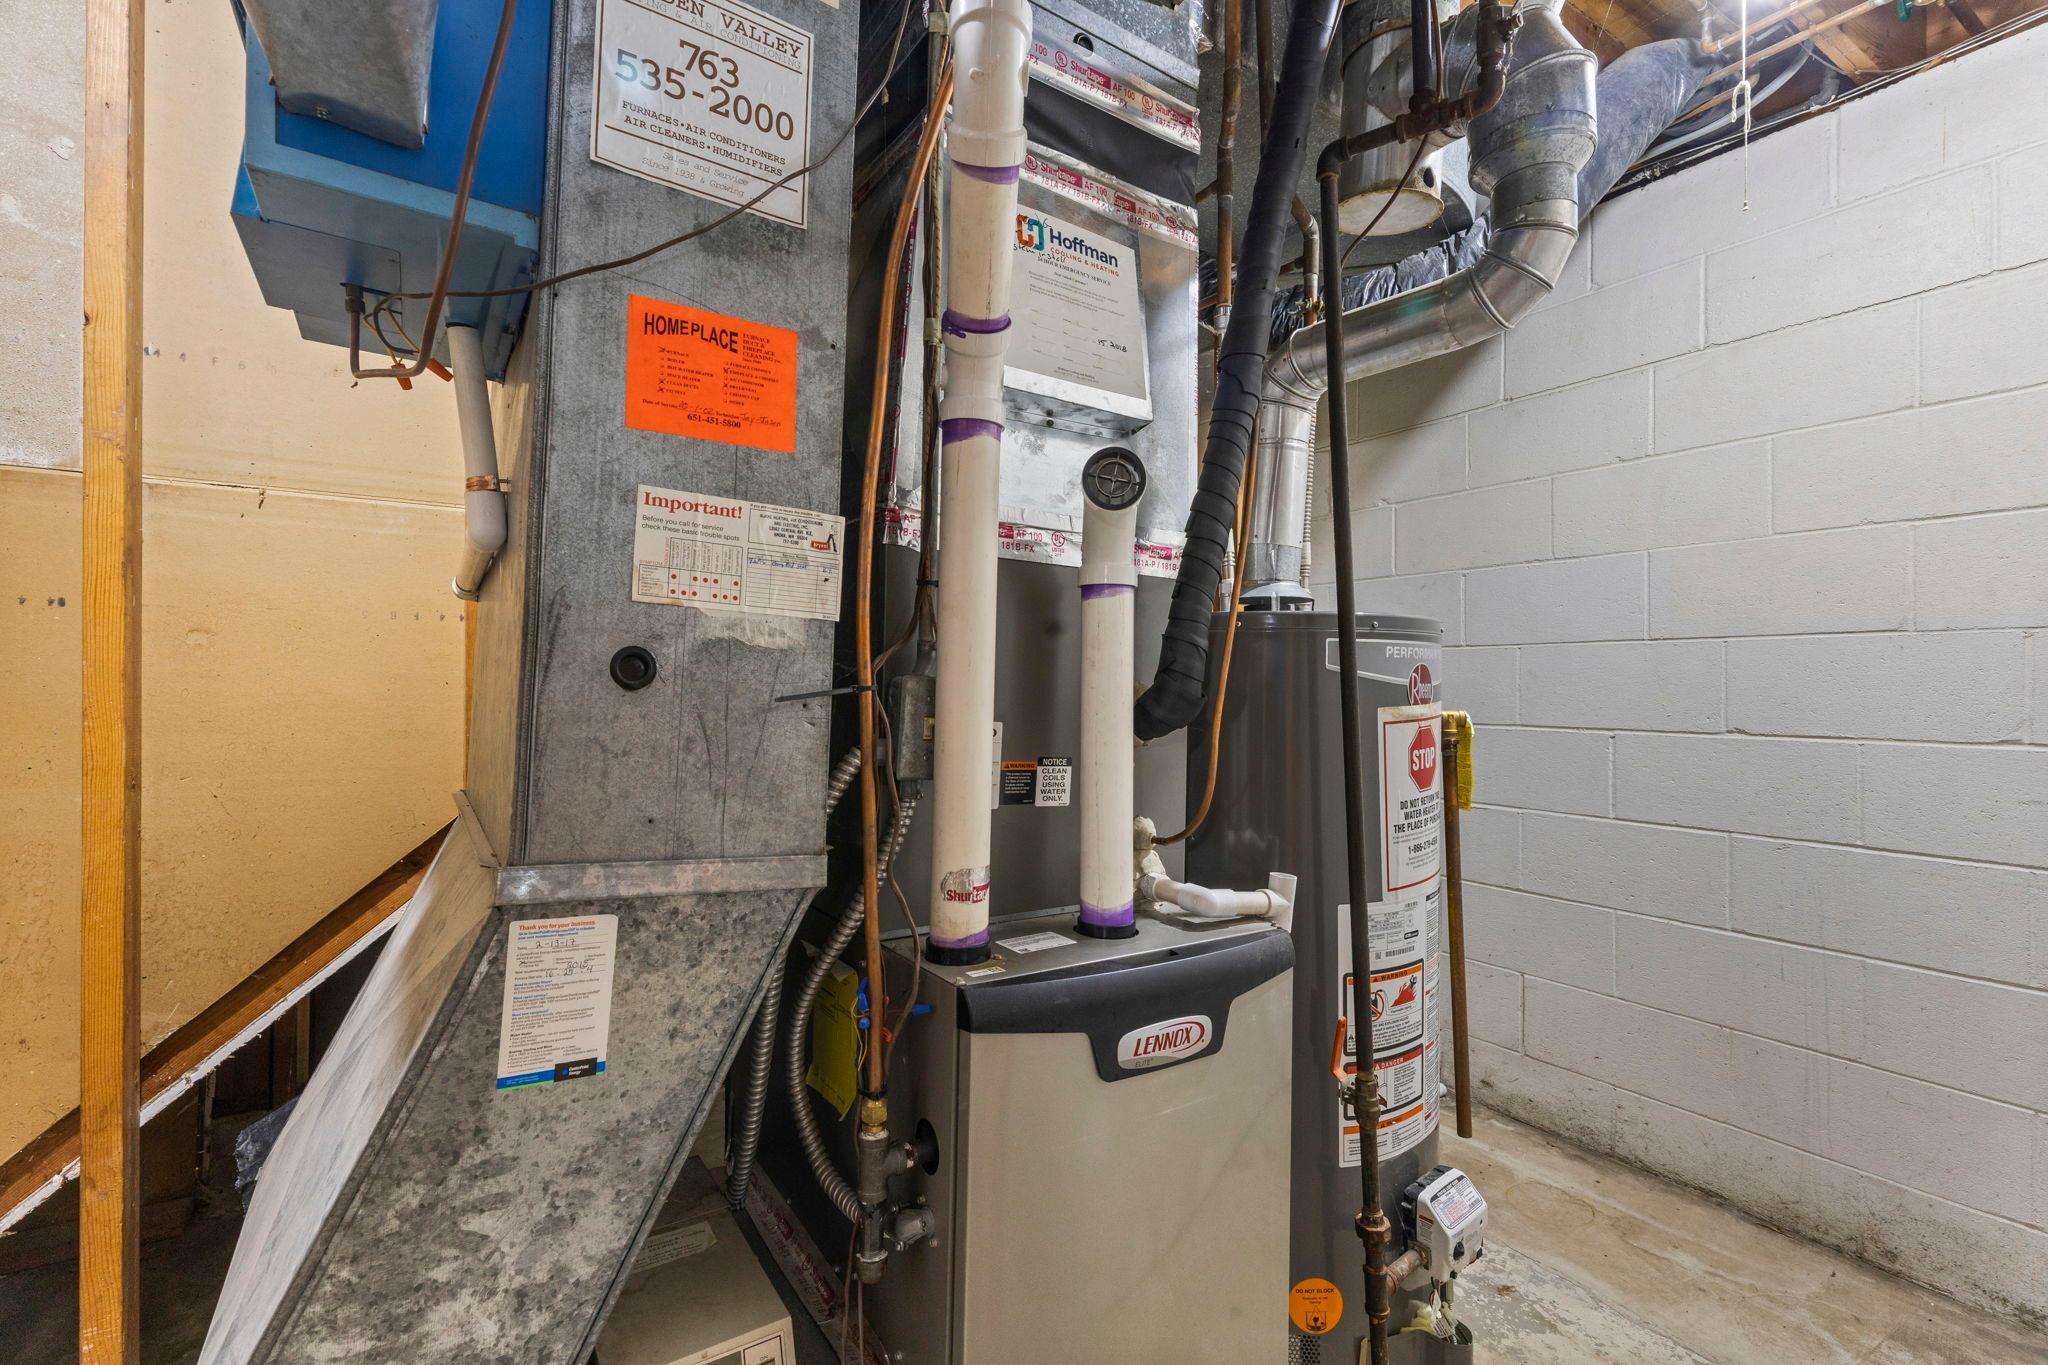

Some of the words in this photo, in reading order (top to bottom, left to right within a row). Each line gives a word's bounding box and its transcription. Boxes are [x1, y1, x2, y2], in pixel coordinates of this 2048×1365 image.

[690, 15, 713, 33] AIR
[720, 28, 801, 69] CONDITIONING
[720, 12, 801, 59] VALLEY
[679, 38, 740, 88] 763
[1034, 43, 1048, 57] 100
[1070, 60, 1106, 87] Shurtape
[1113, 83, 1122, 92] AF
[1124, 88, 1136, 101] 100
[615, 47, 794, 141] 535-2000
[622, 100, 679, 127] FURNACES
[685, 122, 707, 137] AIR
[709, 131, 786, 166] CONDITIONERS
[623, 114, 647, 130] AIR
[650, 122, 705, 149] CLEANERS
[712, 145, 783, 177] HUMIDIFIERS
[641, 157, 670, 173] Since
[674, 166, 696, 181] 1938
[709, 179, 745, 198] Growing
[662, 151, 690, 166] Sales
[693, 162, 710, 174] and
[713, 168, 750, 186] Service
[1040, 162, 1076, 184] Shurtape
[1084, 181, 1094, 191] AF
[1096, 184, 1108, 197] 100
[1137, 207, 1147, 216] AF
[1148, 211, 1160, 222] 100
[1126, 213, 1153, 231] 181B-FX
[1049, 228, 1118, 268] Hoffman
[1050, 246, 1082, 264] COOLING
[1090, 261, 1120, 278] HEATING
[1059, 262, 1090, 280] EMERGENCY
[1091, 274, 1112, 287] SERVICE
[643, 311, 739, 355] HOMEPLACE
[742, 333, 770, 344] FURNACE
[742, 339, 759, 348] DUCT
[742, 345, 775, 356] FIREPLACE
[742, 351, 773, 362] CLEANING
[1109, 340, 1128, 353] 2018
[687, 413, 741, 429] 651-451-5800
[643, 491, 743, 519] Important!
[641, 523, 661, 531] check
[682, 527, 698, 536] basic
[699, 530, 723, 539] trouble
[723, 534, 740, 543] spots
[642, 514, 664, 524] Before
[665, 518, 678, 526] you
[679, 519, 691, 528] call
[702, 524, 724, 532] service
[1001, 541, 1035, 553] 181B-FX
[1029, 532, 1043, 542] 100
[1411, 664, 1432, 705] Rheem
[1042, 758, 1068, 766] NOTICE
[1412, 746, 1435, 772] STOP
[1041, 767, 1067, 775] CLEAN
[1399, 800, 1409, 811] DO
[1409, 797, 1419, 809] NOT
[1420, 794, 1435, 806] RETURN
[1393, 823, 1406, 834] THE
[1407, 819, 1423, 832] PLACE
[1423, 817, 1429, 828] OF
[1404, 808, 1422, 821] WATER
[1380, 969, 1408, 981] WARNING
[1133, 1025, 1193, 1057] LENNOX
[1381, 1057, 1404, 1069] DANGER
